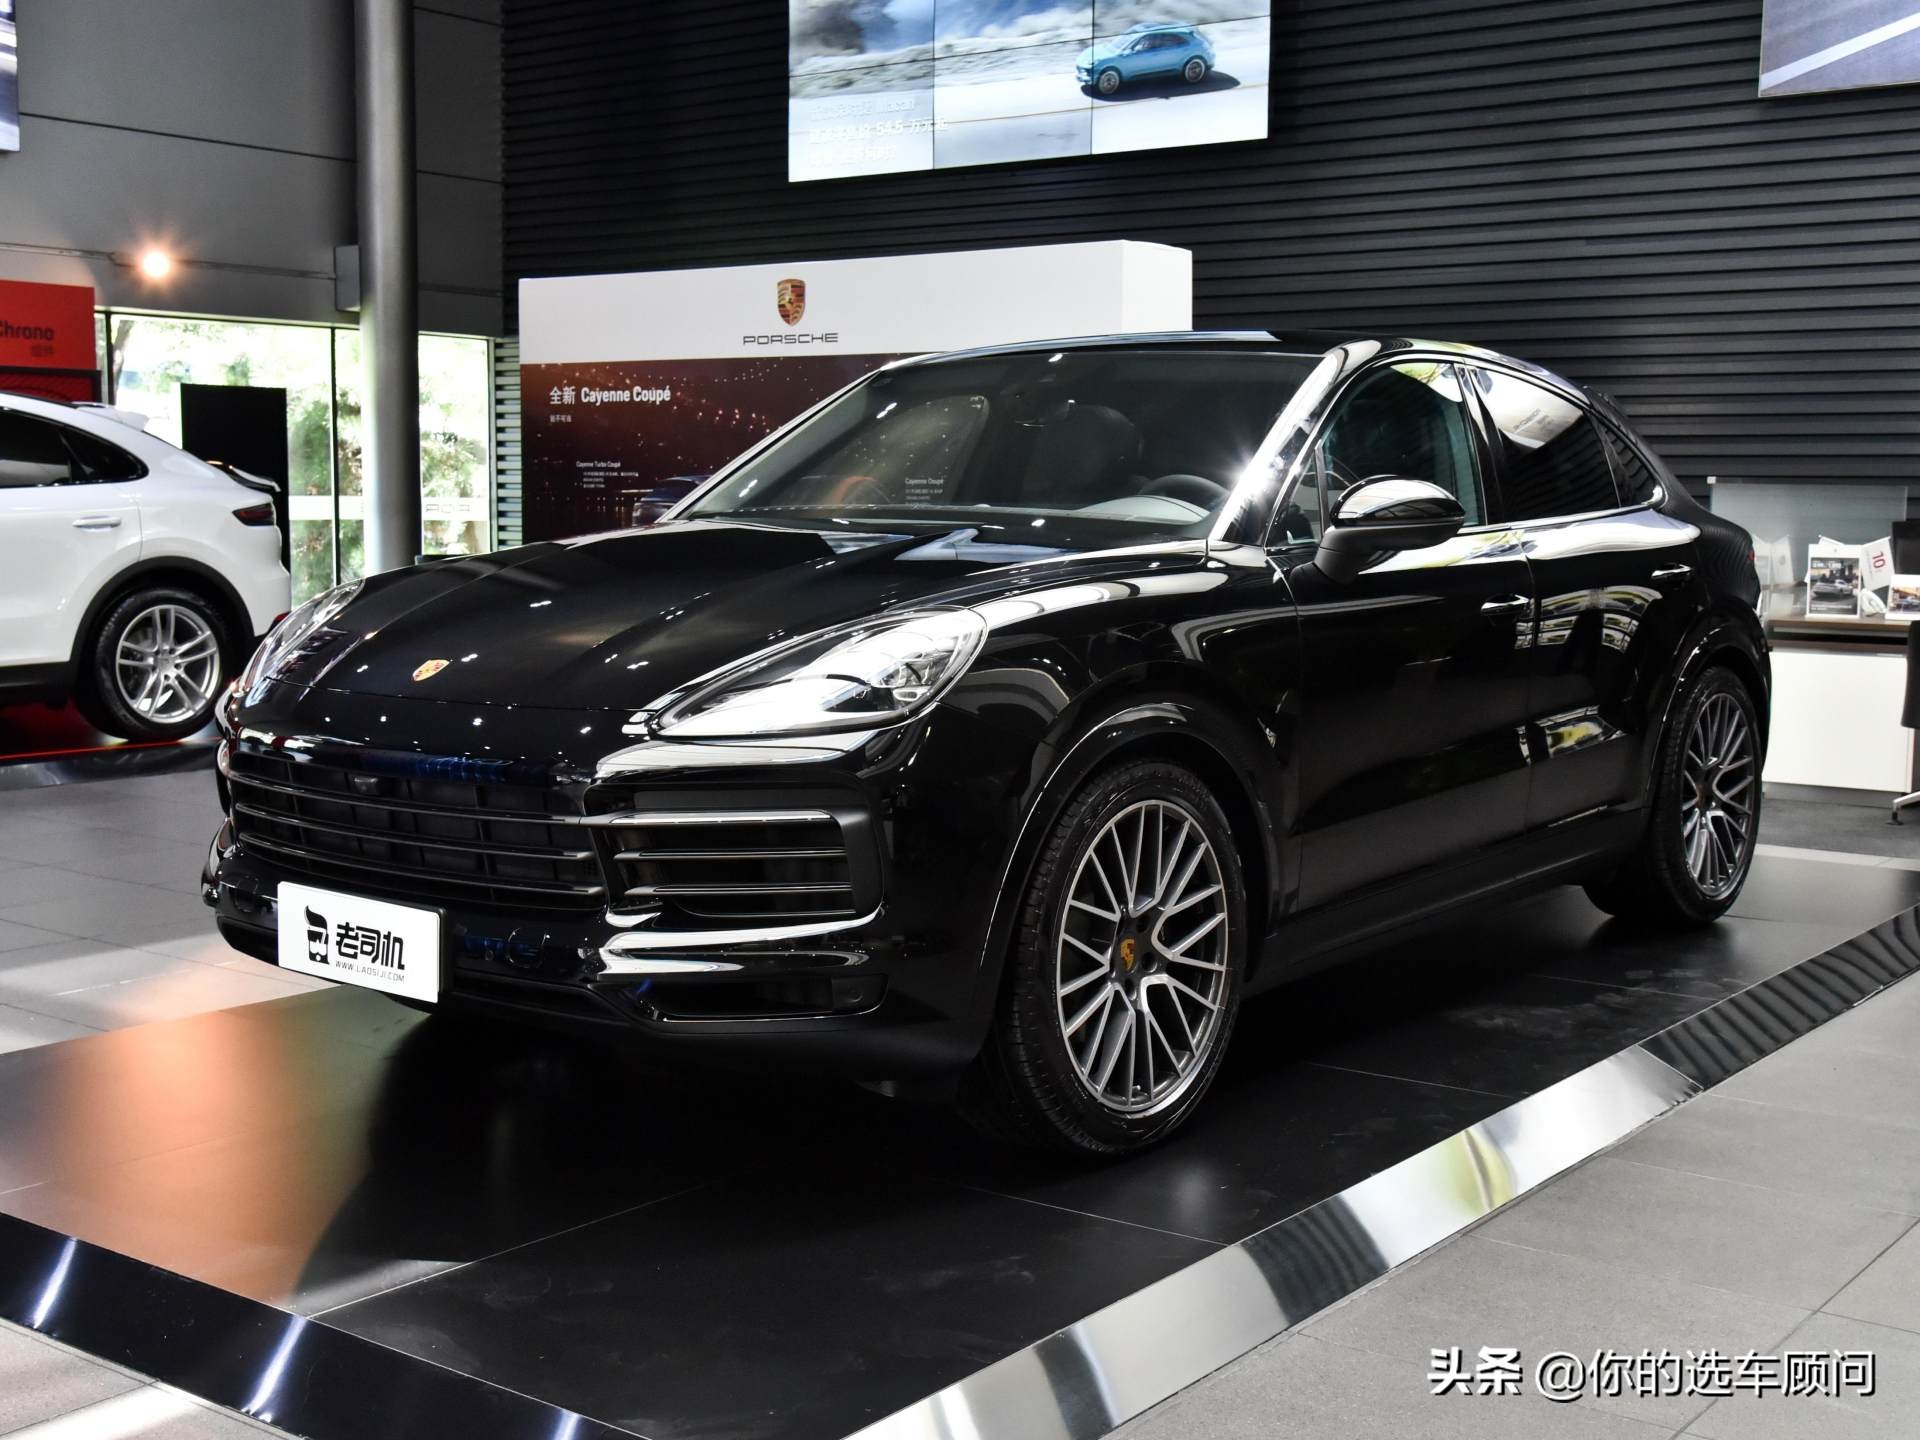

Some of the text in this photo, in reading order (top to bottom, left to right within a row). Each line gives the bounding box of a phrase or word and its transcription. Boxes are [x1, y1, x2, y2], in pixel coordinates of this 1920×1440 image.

[742, 332, 839, 346] PORSCHE
[549, 385, 671, 407] 全新 Cayenne Coupé
[335, 921, 406, 971] 老司机
